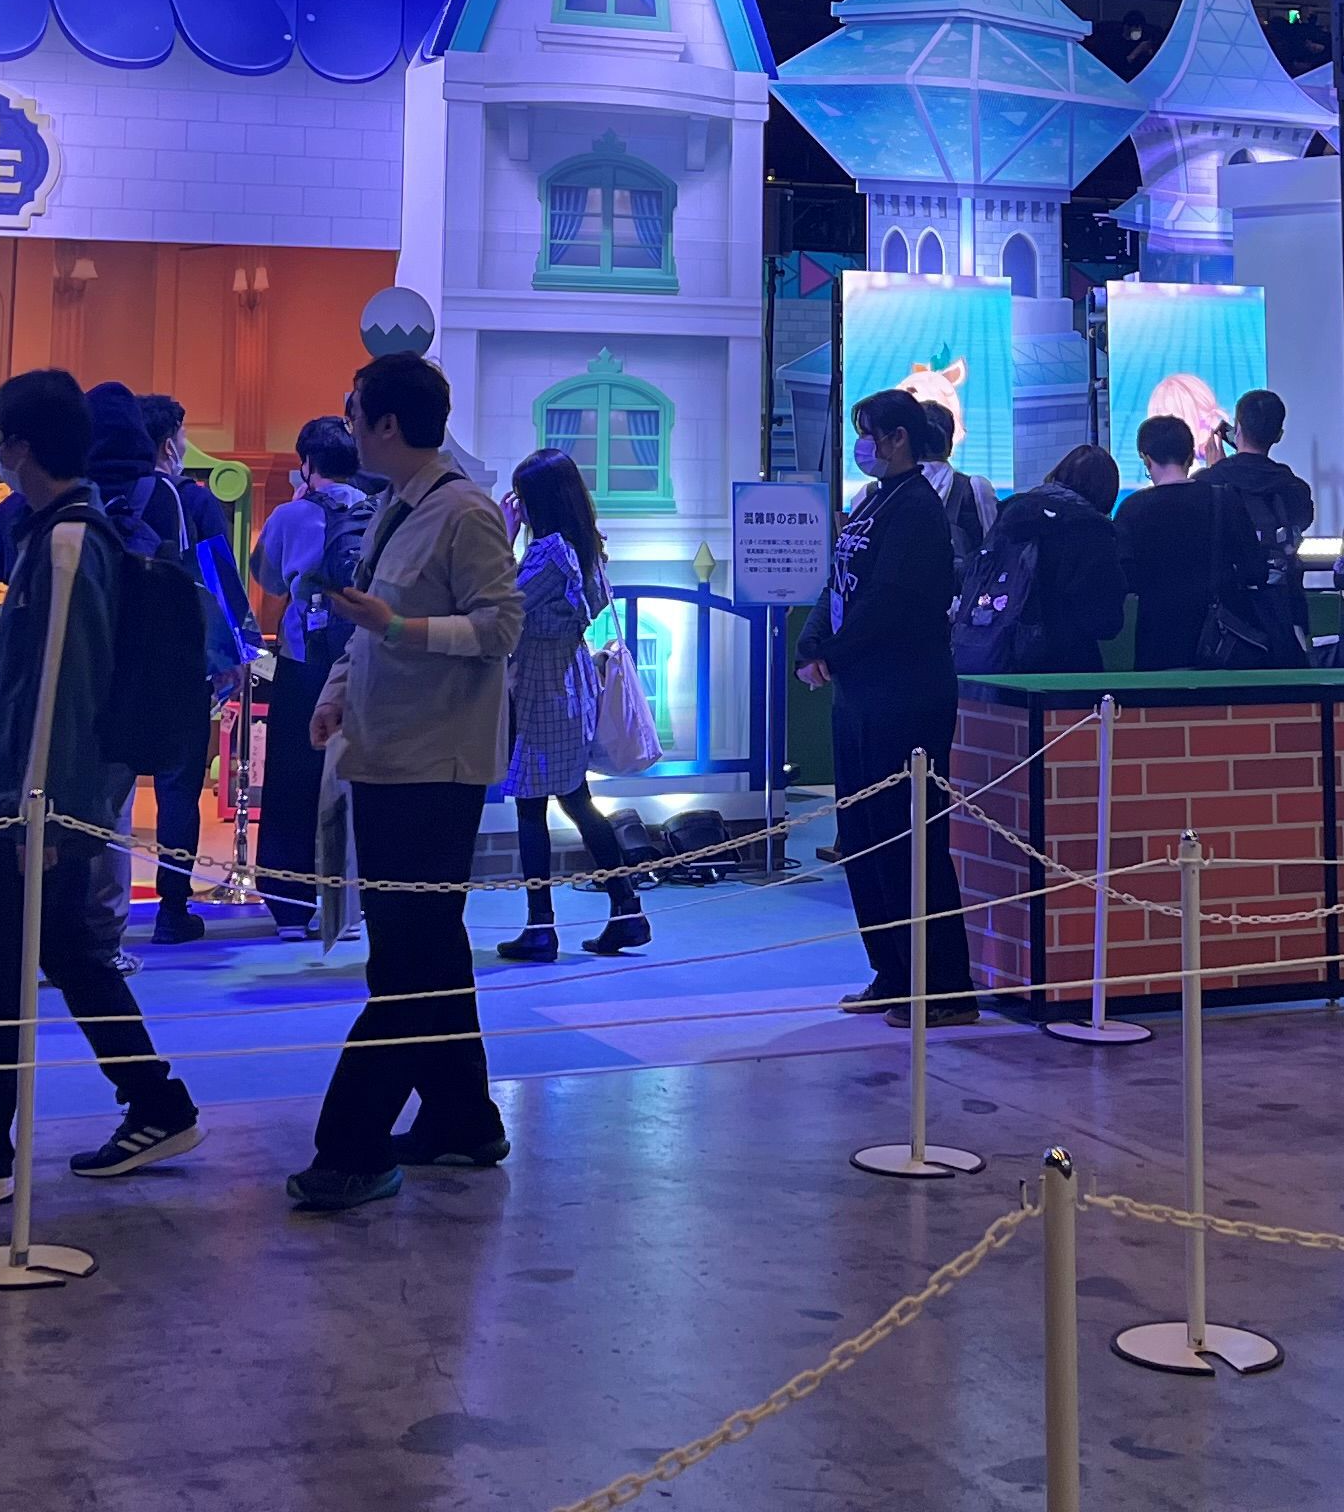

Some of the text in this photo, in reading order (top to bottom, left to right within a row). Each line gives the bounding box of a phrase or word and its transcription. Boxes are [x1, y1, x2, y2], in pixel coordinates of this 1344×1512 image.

[744, 512, 819, 525] 混雑時のお願い
